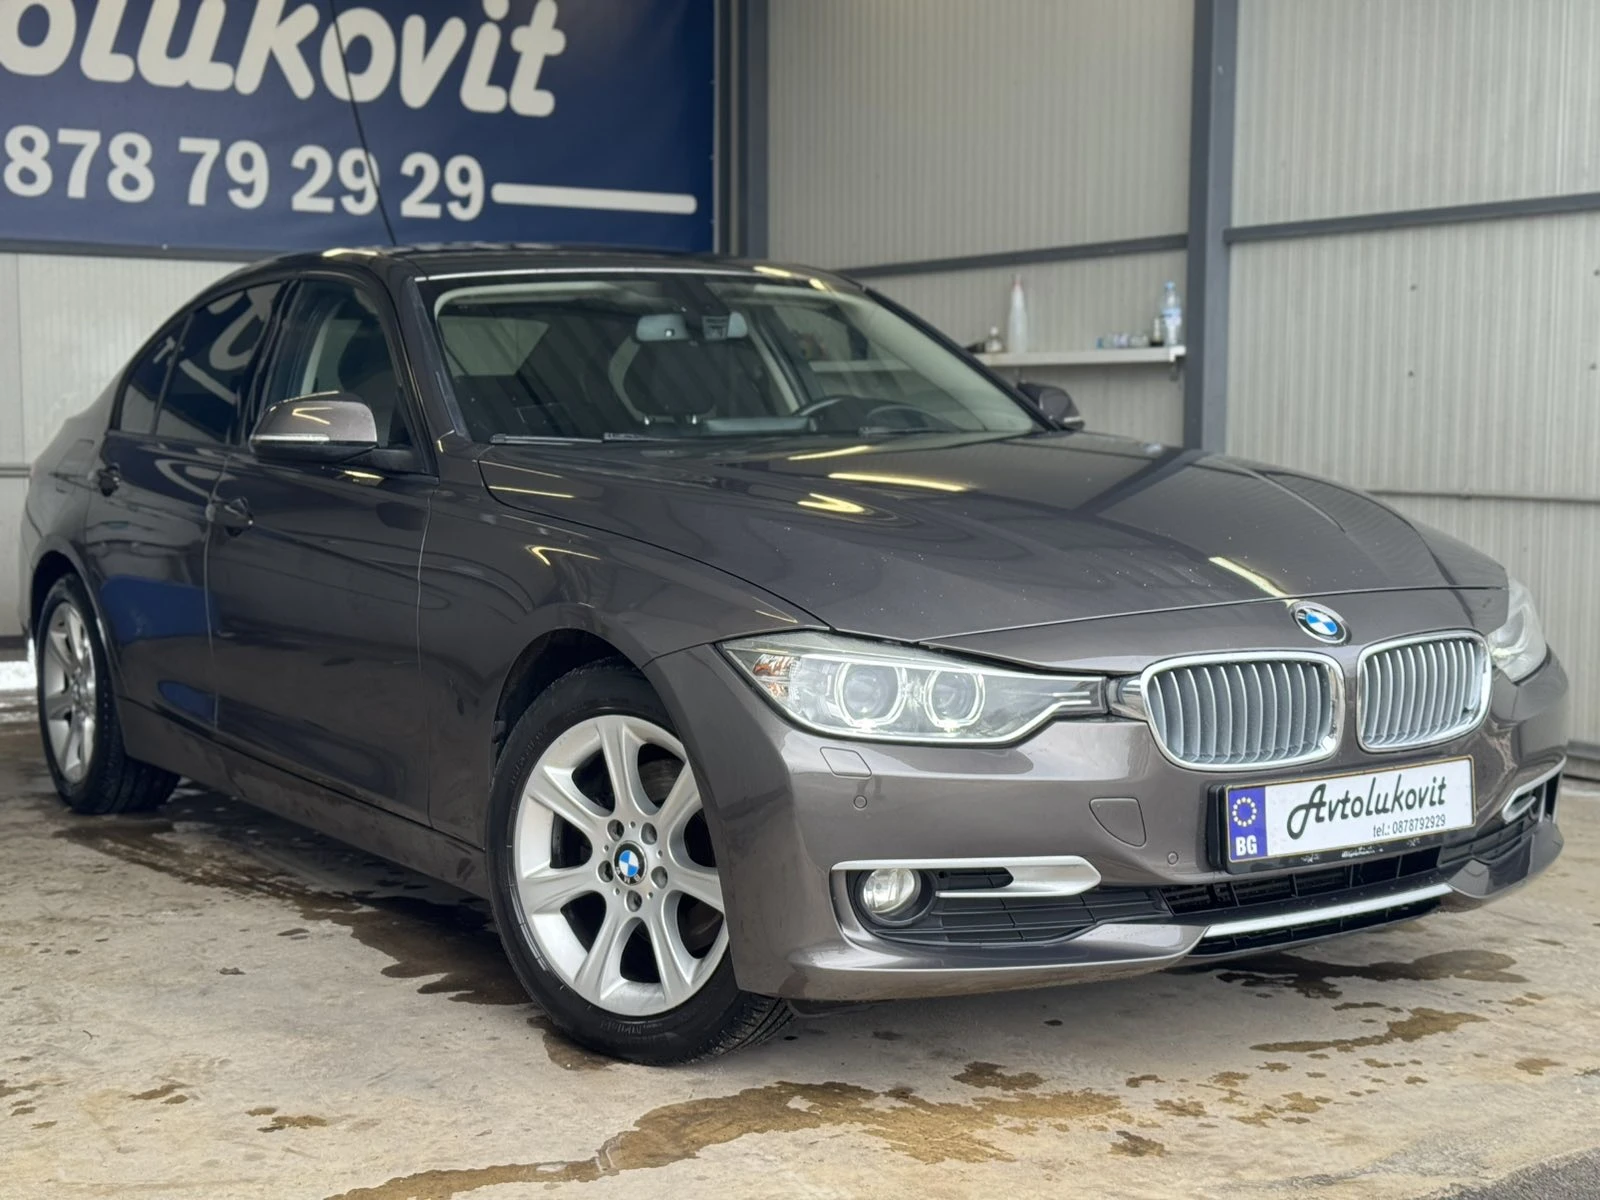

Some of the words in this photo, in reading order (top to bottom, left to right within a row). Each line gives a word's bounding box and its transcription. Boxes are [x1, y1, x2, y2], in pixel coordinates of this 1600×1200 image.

[0, 0, 566, 117] olukovit
[3, 124, 155, 203] 878
[178, 136, 270, 209] 79
[291, 144, 381, 216] 29
[400, 151, 485, 222] 29
[1286, 773, 1447, 840] Avtolukovit
[1391, 814, 1447, 836] 0878792929
[1235, 835, 1258, 856] BG
